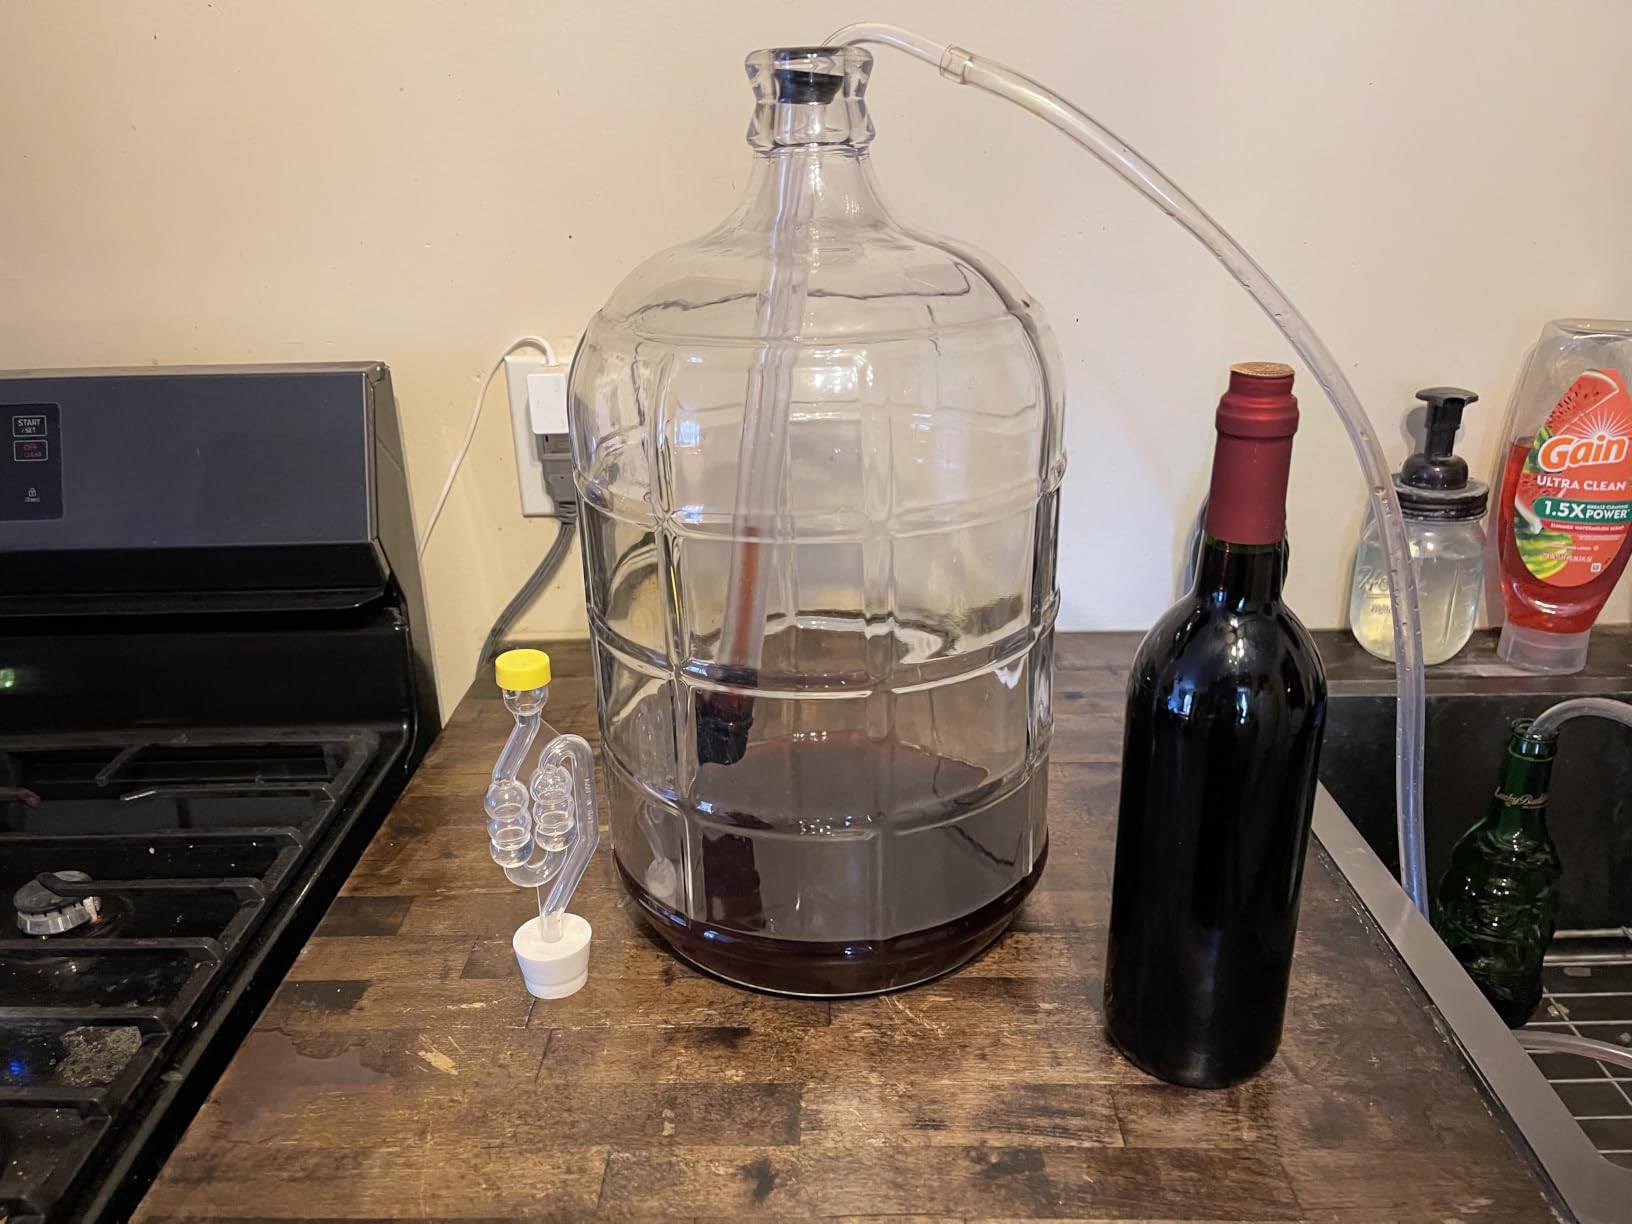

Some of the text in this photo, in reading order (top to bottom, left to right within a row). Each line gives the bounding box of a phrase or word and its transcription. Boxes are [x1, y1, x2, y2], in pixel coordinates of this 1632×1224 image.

[17, 419, 41, 427] START
[1538, 432, 1629, 472] Gain
[1537, 475, 1627, 491] ULTRA CLEAN
[1544, 500, 1586, 519] 1.5X
